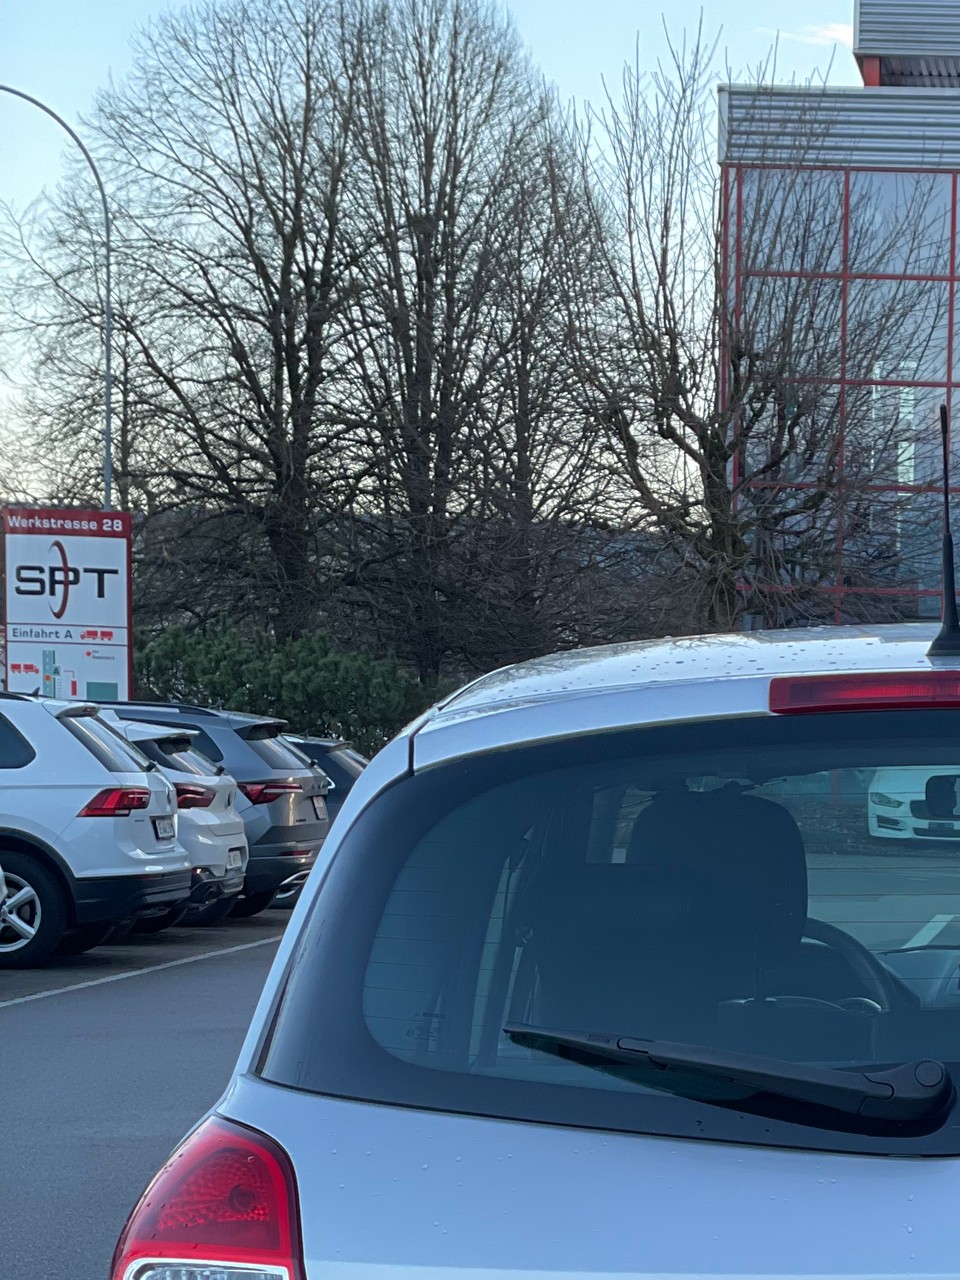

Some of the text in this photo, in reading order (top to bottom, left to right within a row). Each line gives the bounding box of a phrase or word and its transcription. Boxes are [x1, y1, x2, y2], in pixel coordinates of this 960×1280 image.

[7, 515, 123, 532] Werkstrasse 28
[14, 565, 119, 599] SPT
[12, 627, 73, 639] Einfahrt A
[53, 666, 60, 676] A
